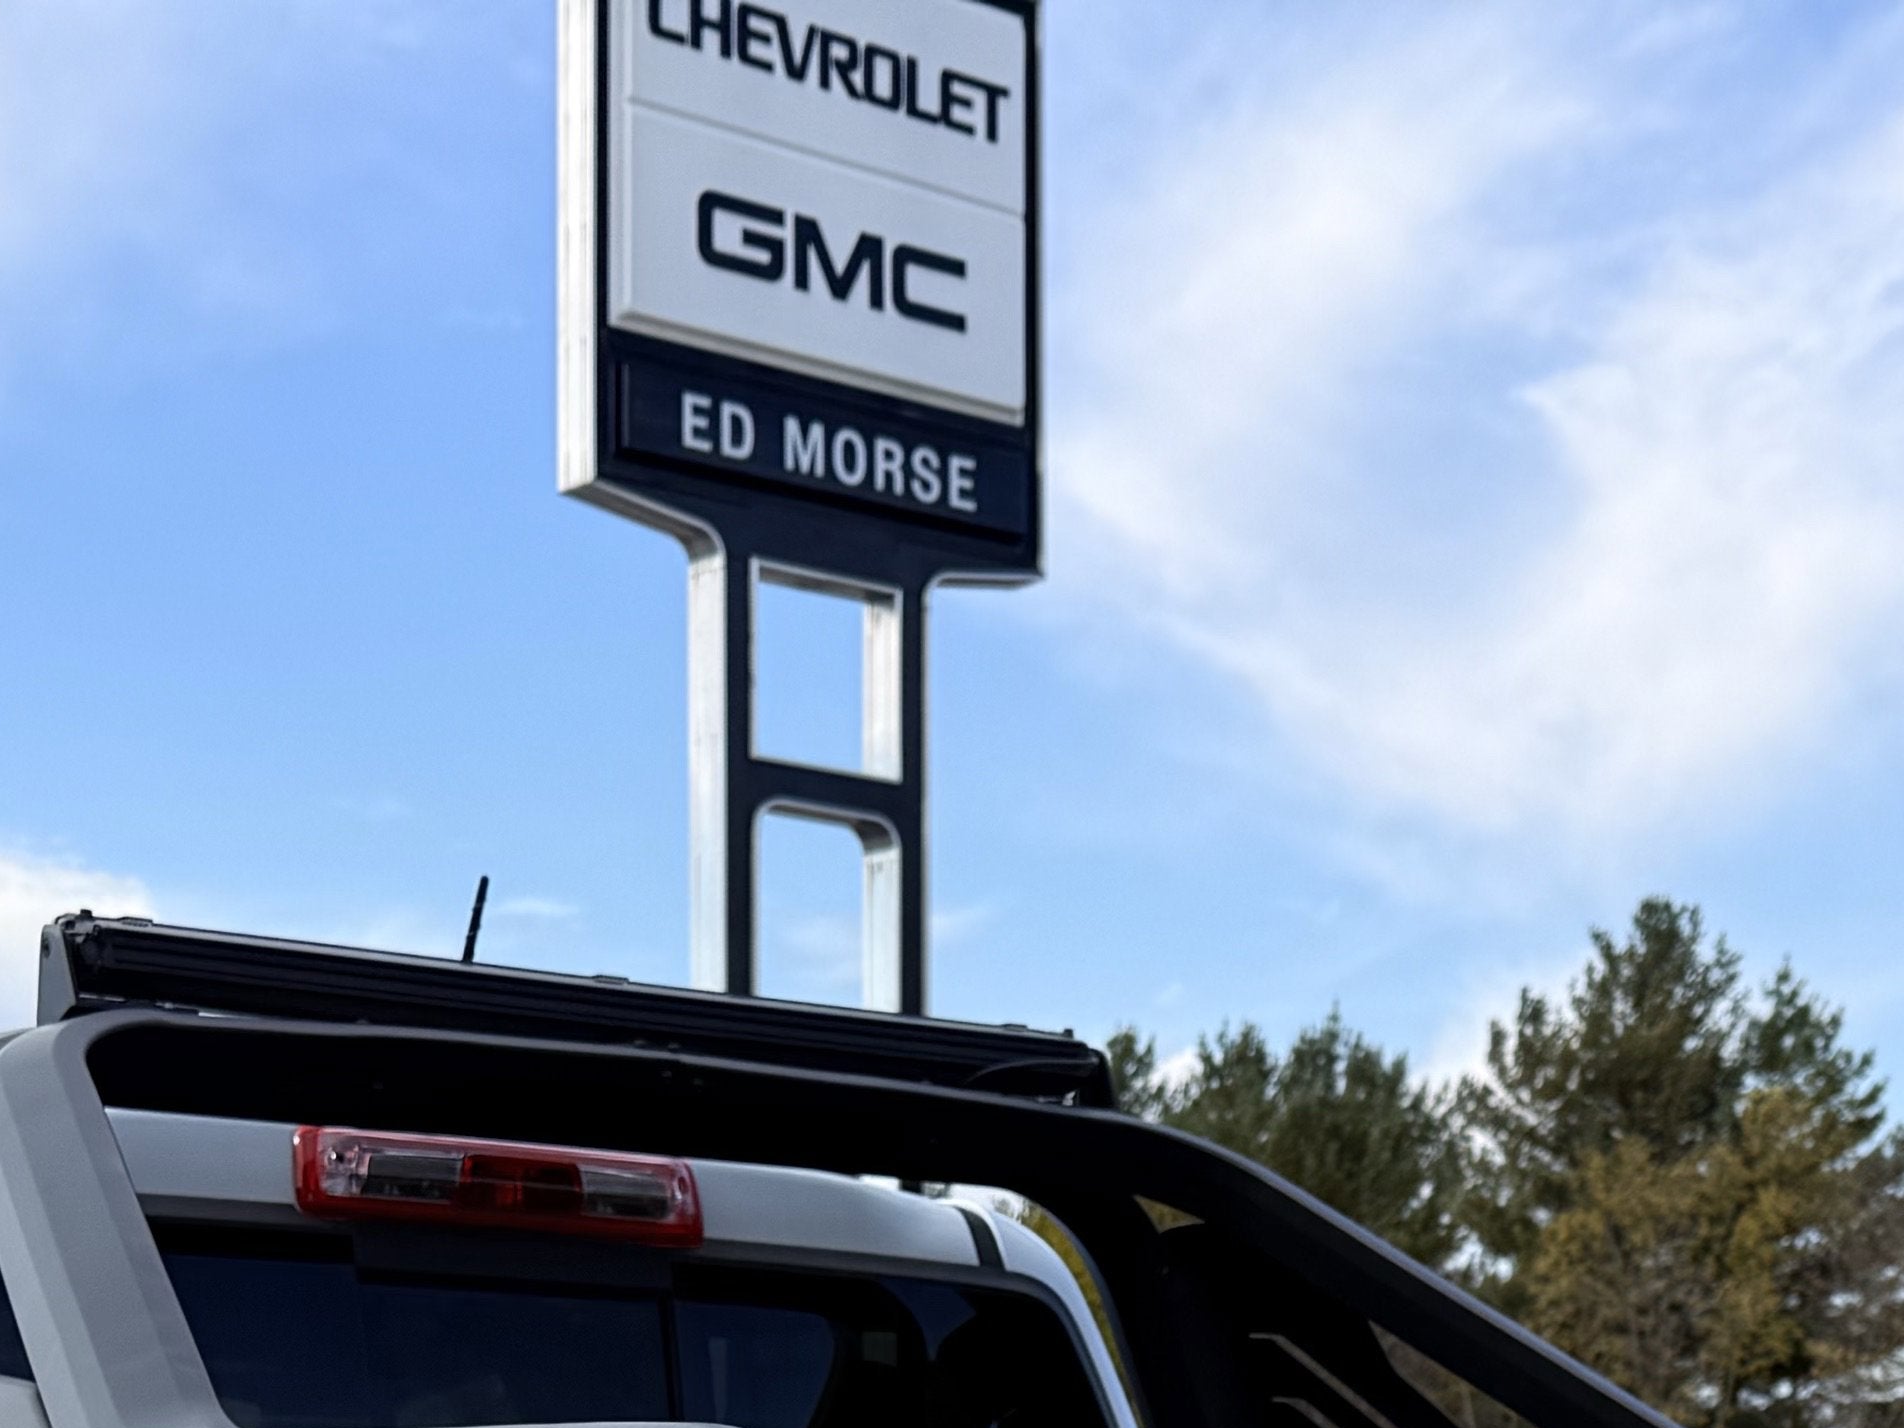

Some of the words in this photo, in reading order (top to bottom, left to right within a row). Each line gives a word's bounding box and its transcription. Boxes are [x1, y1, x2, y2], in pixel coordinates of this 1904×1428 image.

[648, 0, 1010, 144] CHEVROLET
[697, 189, 967, 334] GMC
[680, 391, 755, 461] ED
[782, 415, 978, 512] MORSE
